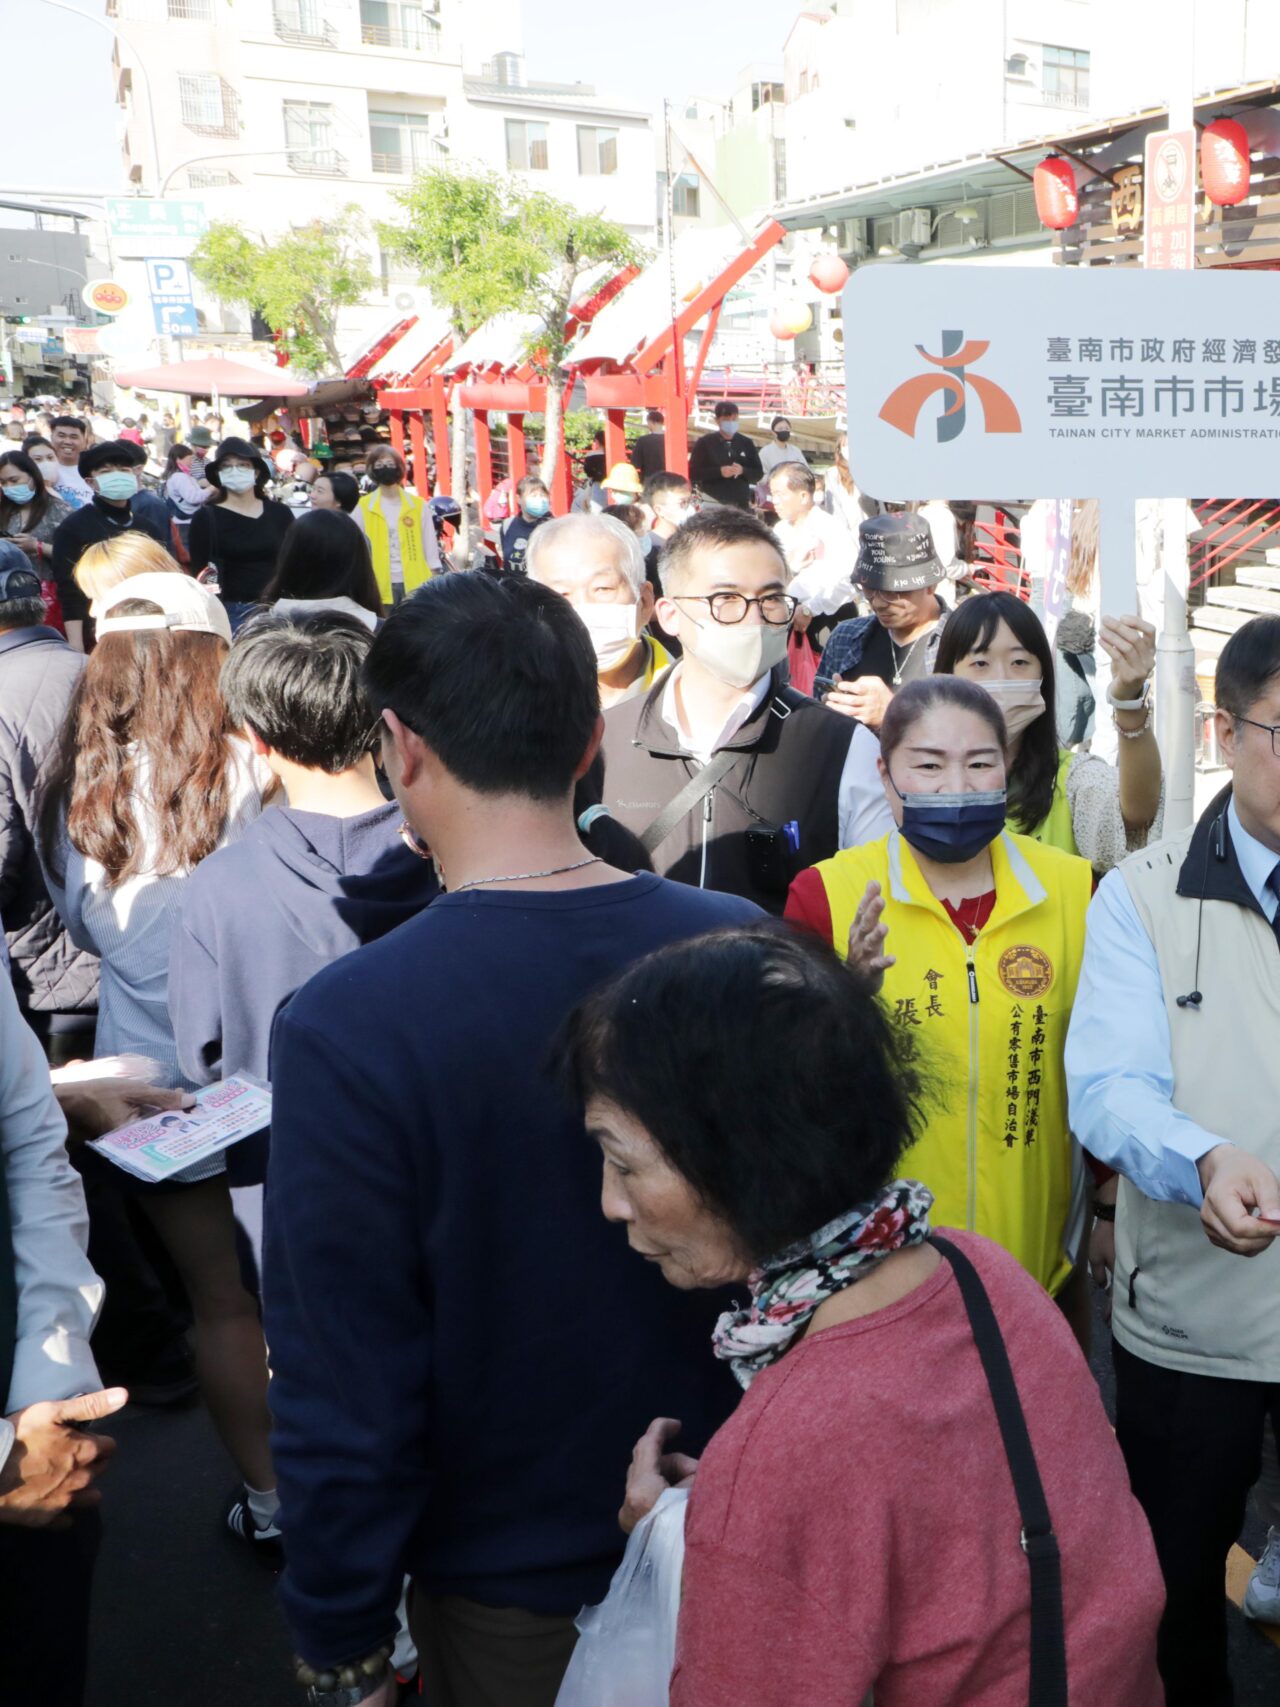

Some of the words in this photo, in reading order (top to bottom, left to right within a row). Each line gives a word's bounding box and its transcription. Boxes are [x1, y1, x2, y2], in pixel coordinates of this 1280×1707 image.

[154, 264, 174, 290] P
[1049, 428, 1096, 439] TAINAN
[1101, 428, 1131, 439] CITY
[1135, 428, 1186, 439] MARKET
[923, 968, 945, 1018] 會長
[1002, 1003, 1025, 1148] 公有零售市場自治會
[1024, 1005, 1048, 1147] 臺南市西門淺草
